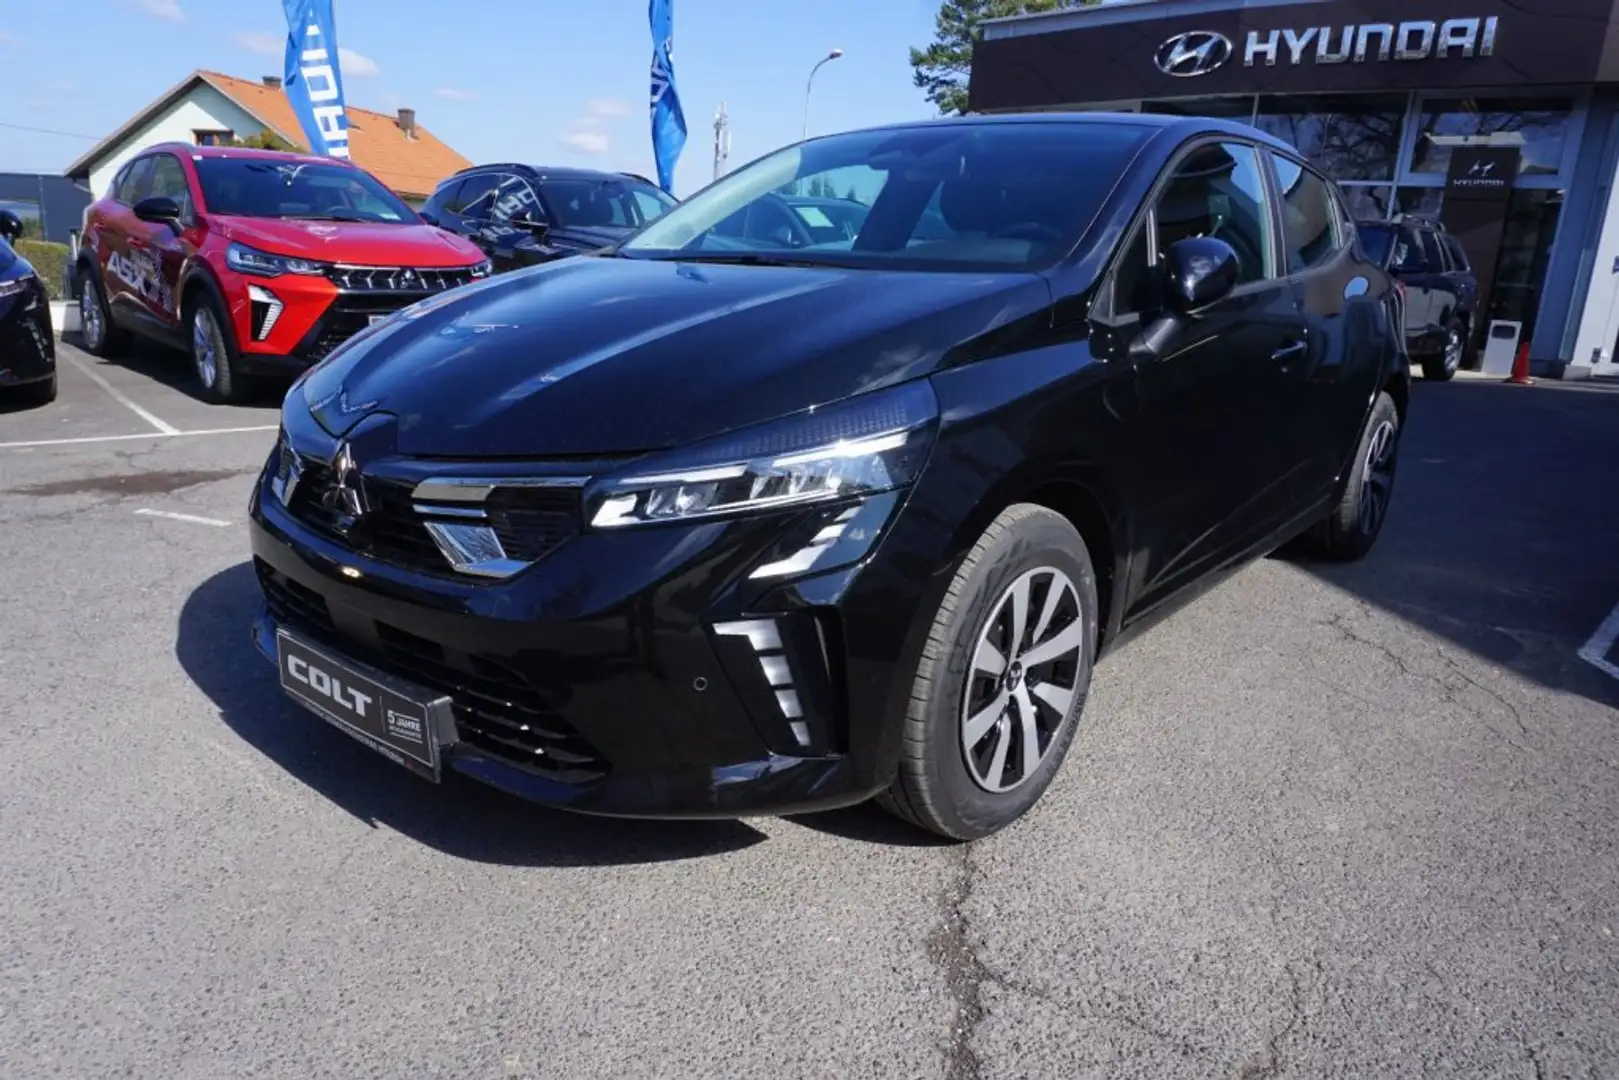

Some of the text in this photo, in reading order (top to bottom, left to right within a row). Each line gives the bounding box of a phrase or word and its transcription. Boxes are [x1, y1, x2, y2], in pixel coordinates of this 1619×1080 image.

[1244, 15, 1499, 67] HYUNDAI
[287, 653, 373, 718] COLT
[387, 709, 395, 725] 5
